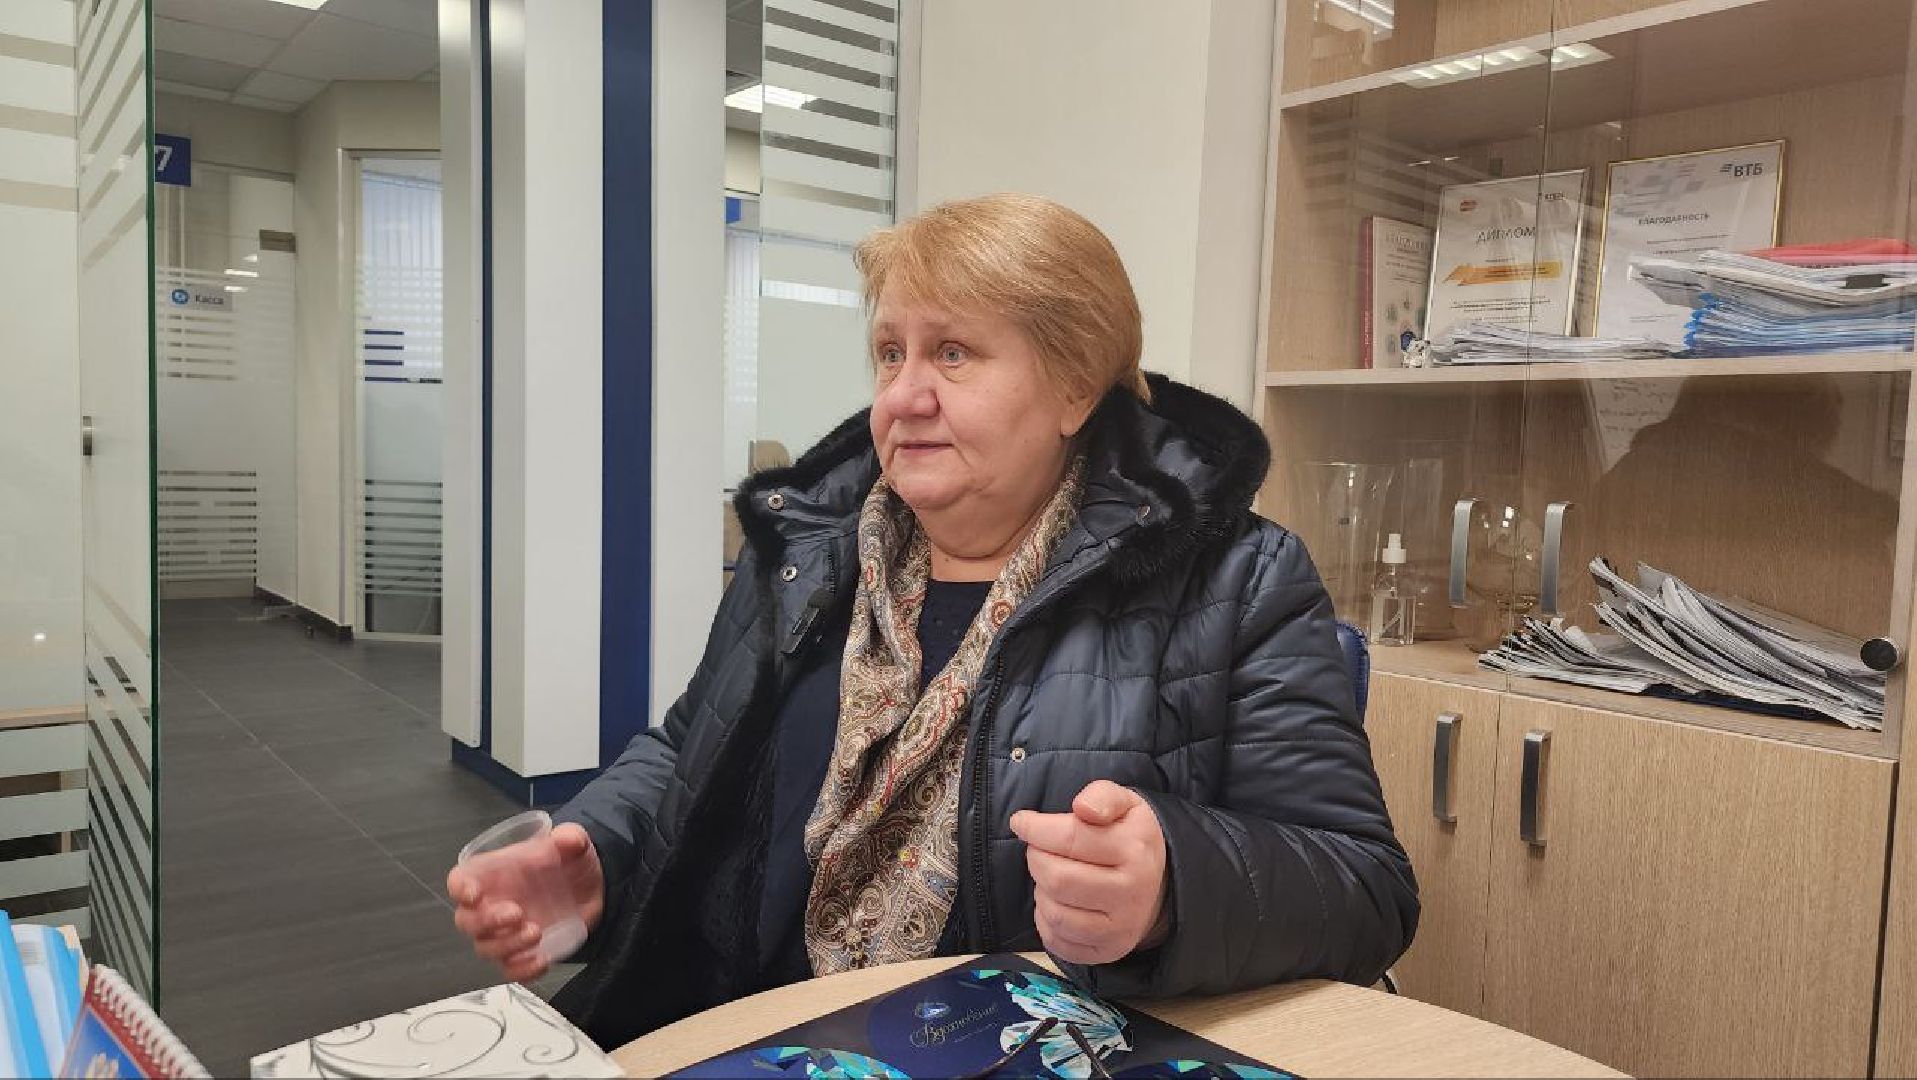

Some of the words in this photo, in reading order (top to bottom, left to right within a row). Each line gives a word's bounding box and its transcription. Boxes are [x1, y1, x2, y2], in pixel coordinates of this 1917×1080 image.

[155, 145, 172, 171] 7
[1734, 163, 1763, 177] ВТБ
[1476, 226, 1536, 244] ДИПЛОМ
[195, 294, 224, 304] Касса
